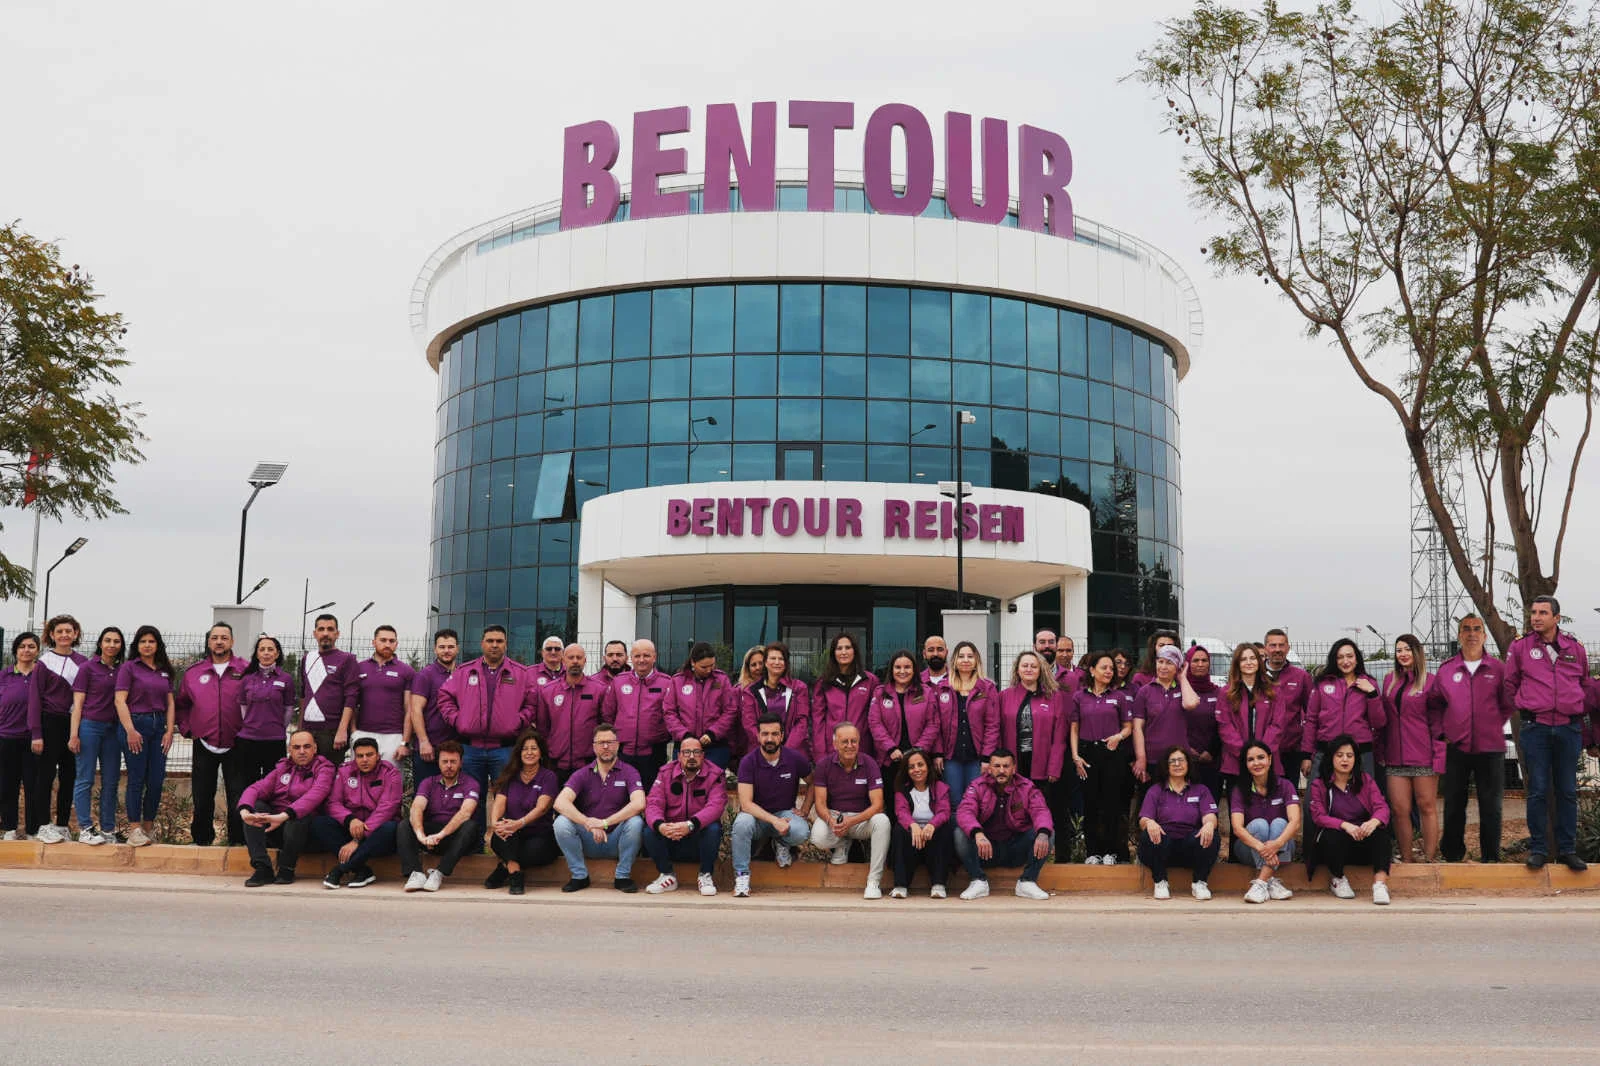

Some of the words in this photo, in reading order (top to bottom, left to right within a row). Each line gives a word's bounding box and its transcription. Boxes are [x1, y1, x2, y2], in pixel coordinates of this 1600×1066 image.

[560, 100, 1074, 240] BENTOUR
[666, 497, 863, 537] BENTOUR
[884, 499, 1025, 543] REISEN
